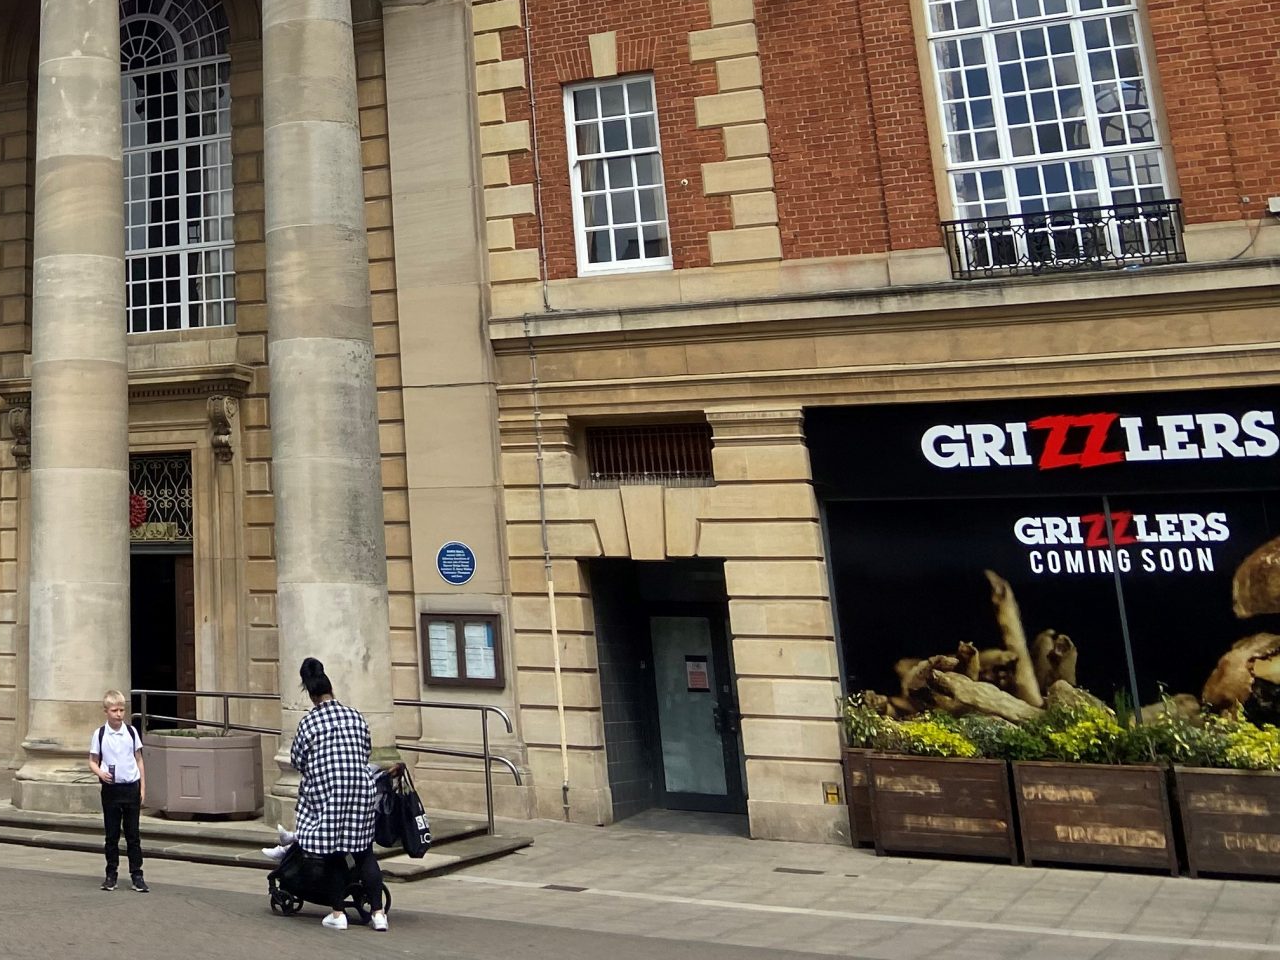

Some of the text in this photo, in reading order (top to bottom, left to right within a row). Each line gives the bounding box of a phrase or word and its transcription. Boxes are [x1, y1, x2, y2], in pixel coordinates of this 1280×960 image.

[921, 411, 1280, 470] GRIZZLERS
[1014, 511, 1230, 547] GRIZZLERS
[1030, 548, 1215, 574] COMING SOON
